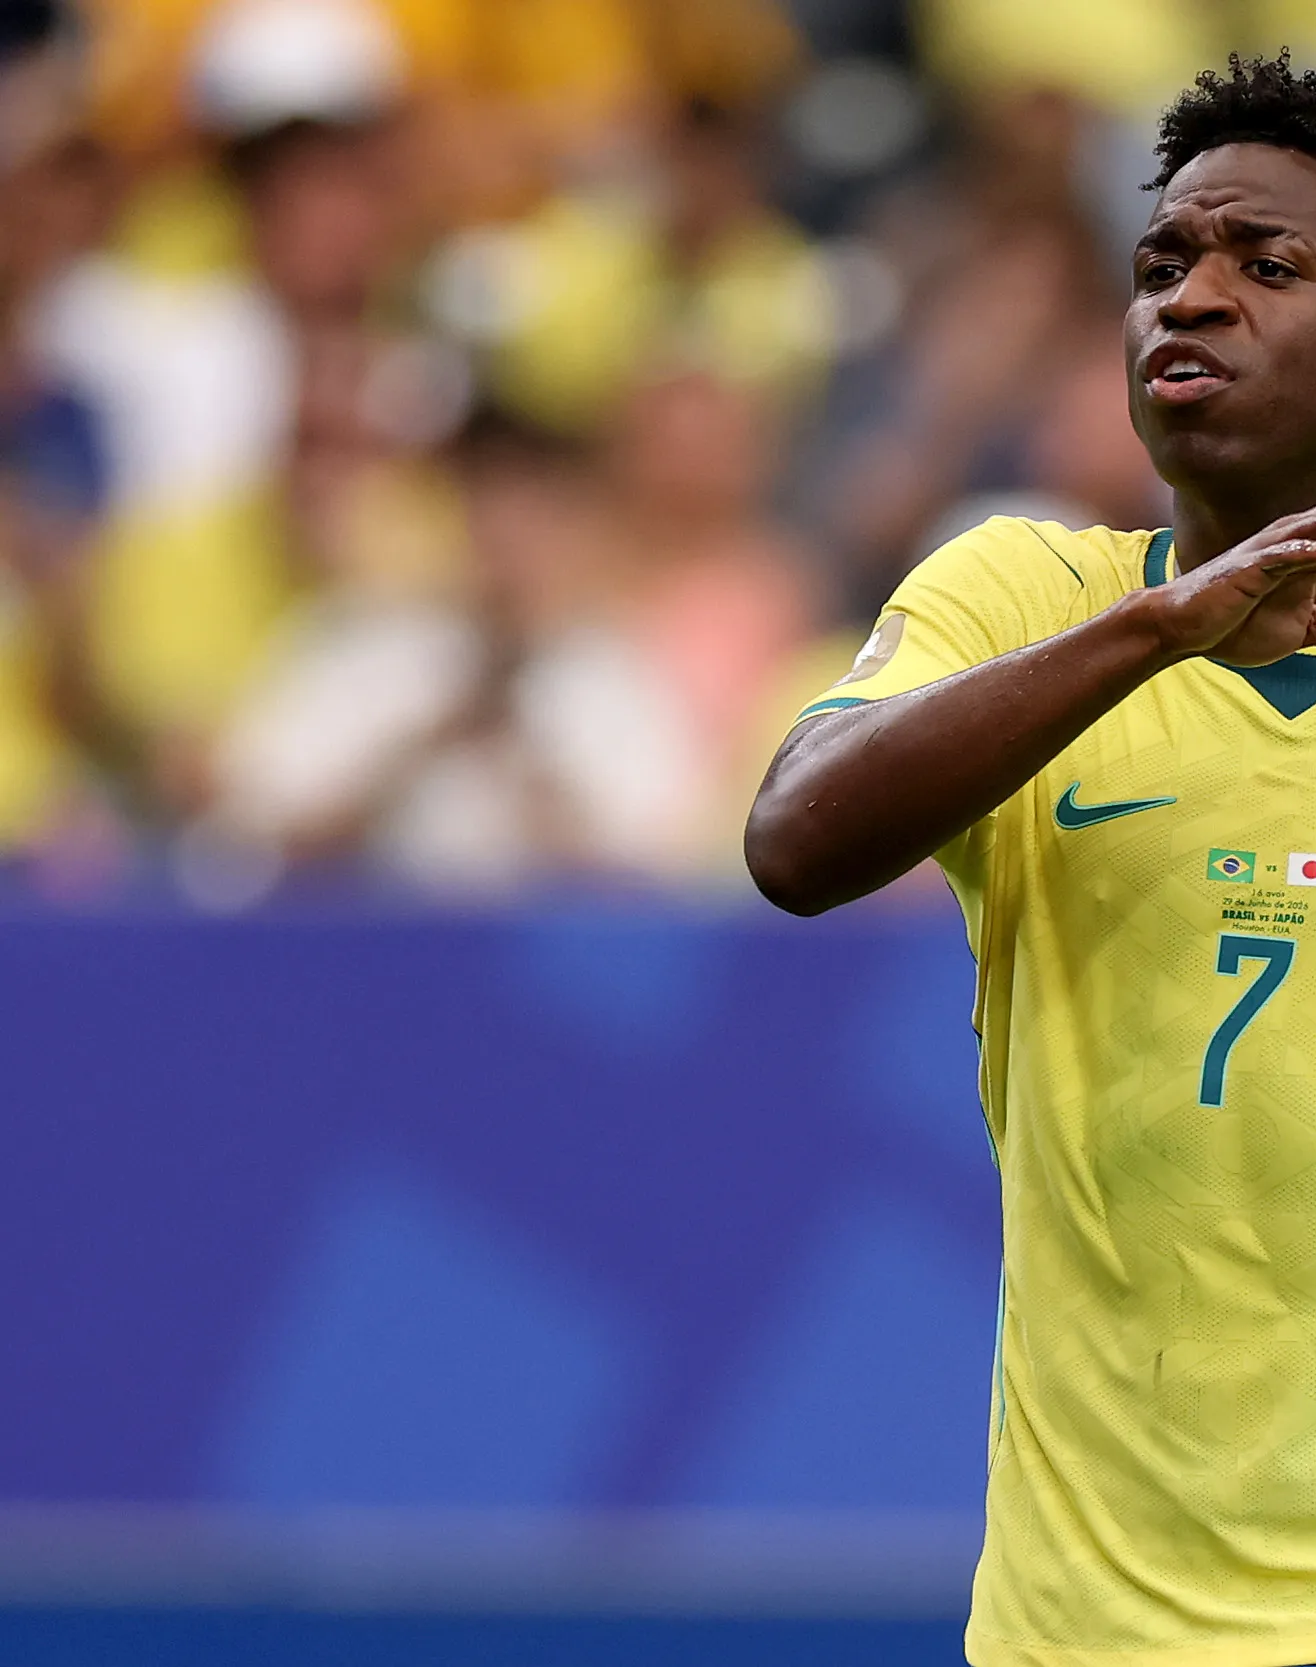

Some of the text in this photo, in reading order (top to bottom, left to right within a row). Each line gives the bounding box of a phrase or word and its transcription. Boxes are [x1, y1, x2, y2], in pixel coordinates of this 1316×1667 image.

[1266, 864, 1277, 872] vs
[1252, 888, 1263, 897] 16
[1274, 901, 1285, 909] de
[1272, 912, 1305, 924] JAPÃO
[1232, 922, 1265, 933] Houston
[1199, 933, 1298, 1108] 7
